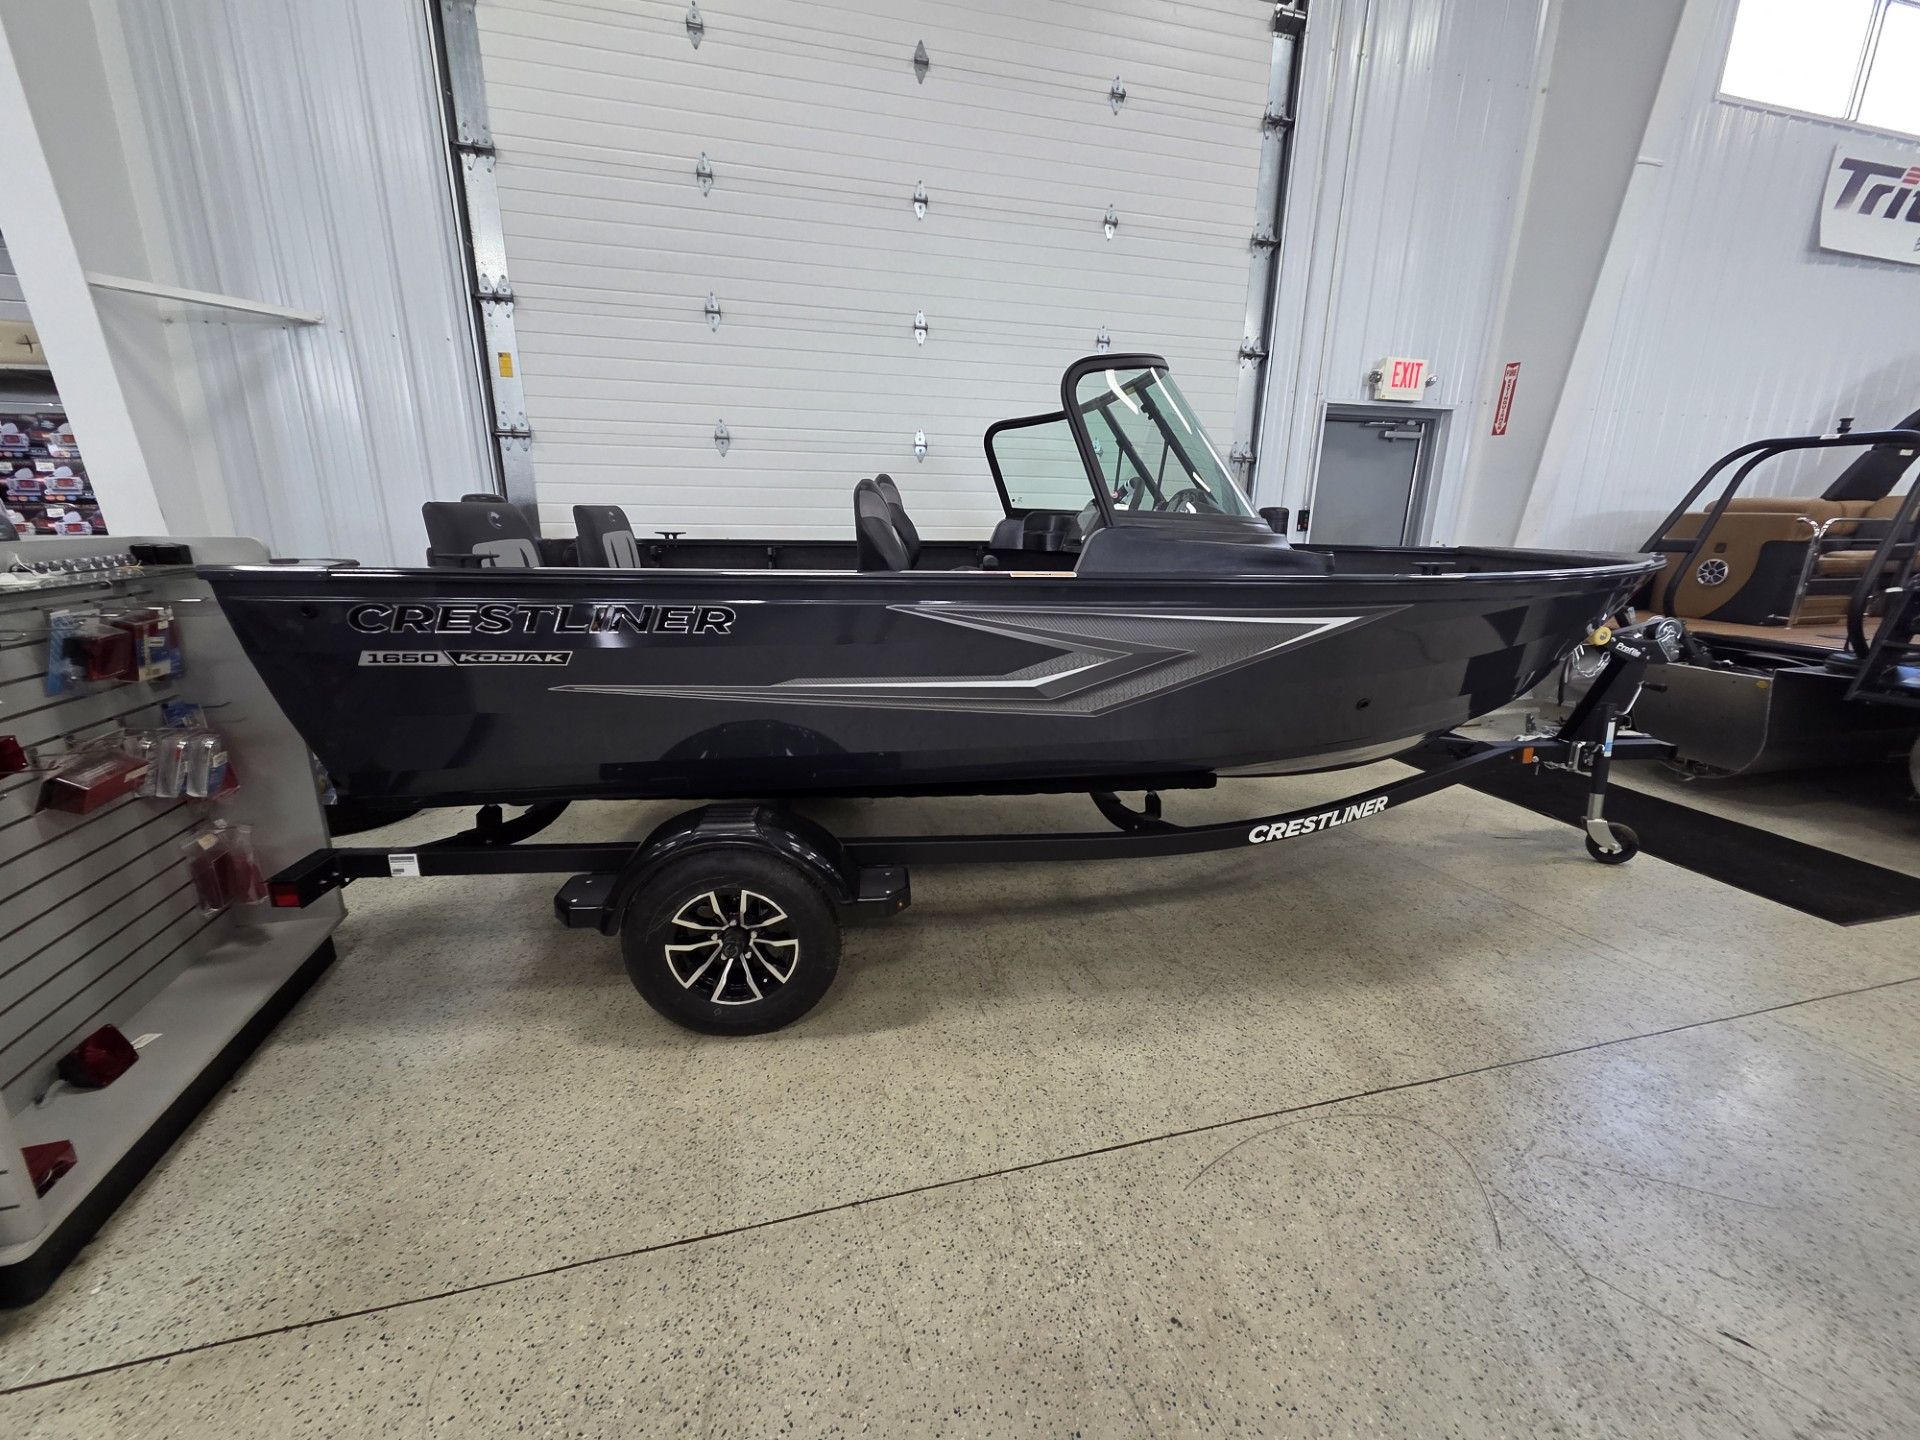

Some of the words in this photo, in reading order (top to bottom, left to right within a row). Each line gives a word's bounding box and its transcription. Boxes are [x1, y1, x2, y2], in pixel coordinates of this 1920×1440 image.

[1391, 361, 1424, 389] EXIT
[346, 603, 736, 634] CRESTLINER
[367, 653, 438, 664] 1650
[459, 653, 564, 663] KODIAK
[1249, 796, 1389, 844] CRESTLINER
